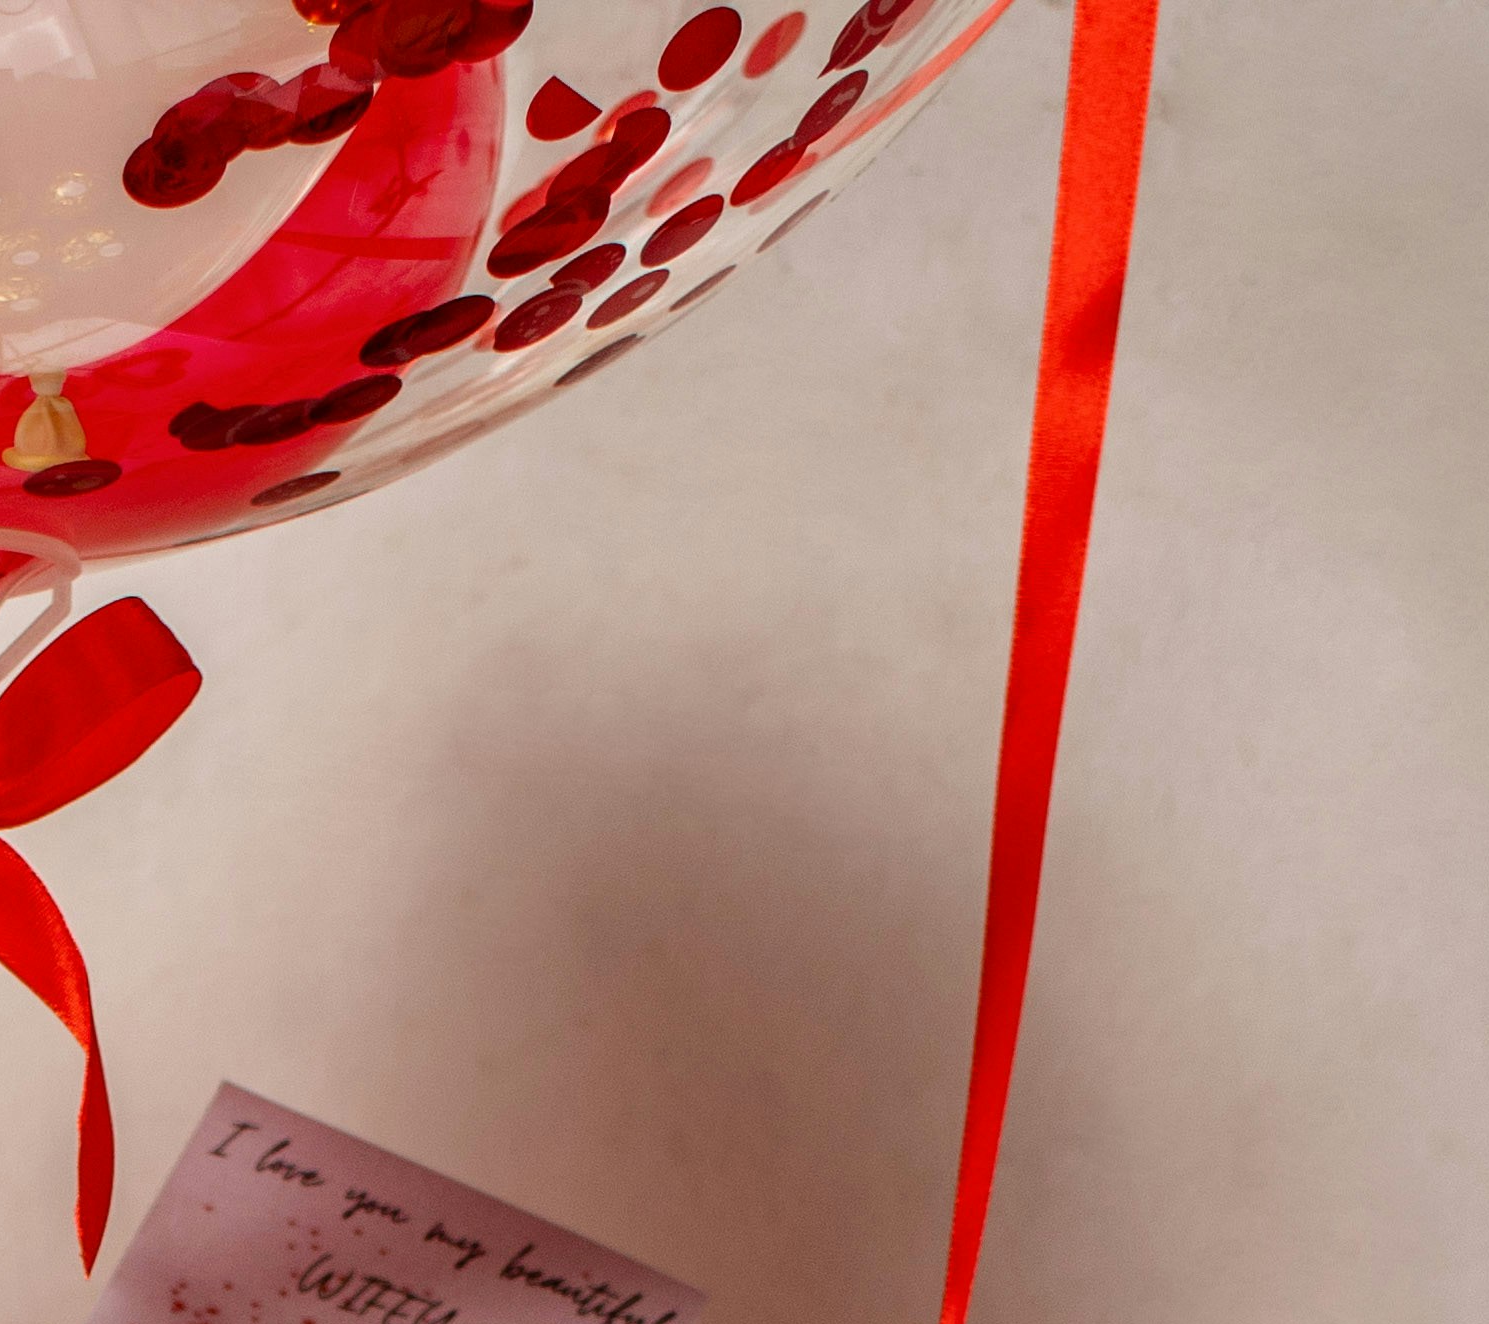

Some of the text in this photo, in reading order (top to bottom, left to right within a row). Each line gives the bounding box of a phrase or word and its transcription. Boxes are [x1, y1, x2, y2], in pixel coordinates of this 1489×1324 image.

[210, 1122, 259, 1157] I
[255, 1139, 325, 1187] love
[342, 1187, 409, 1223] you
[424, 1222, 486, 1269] my
